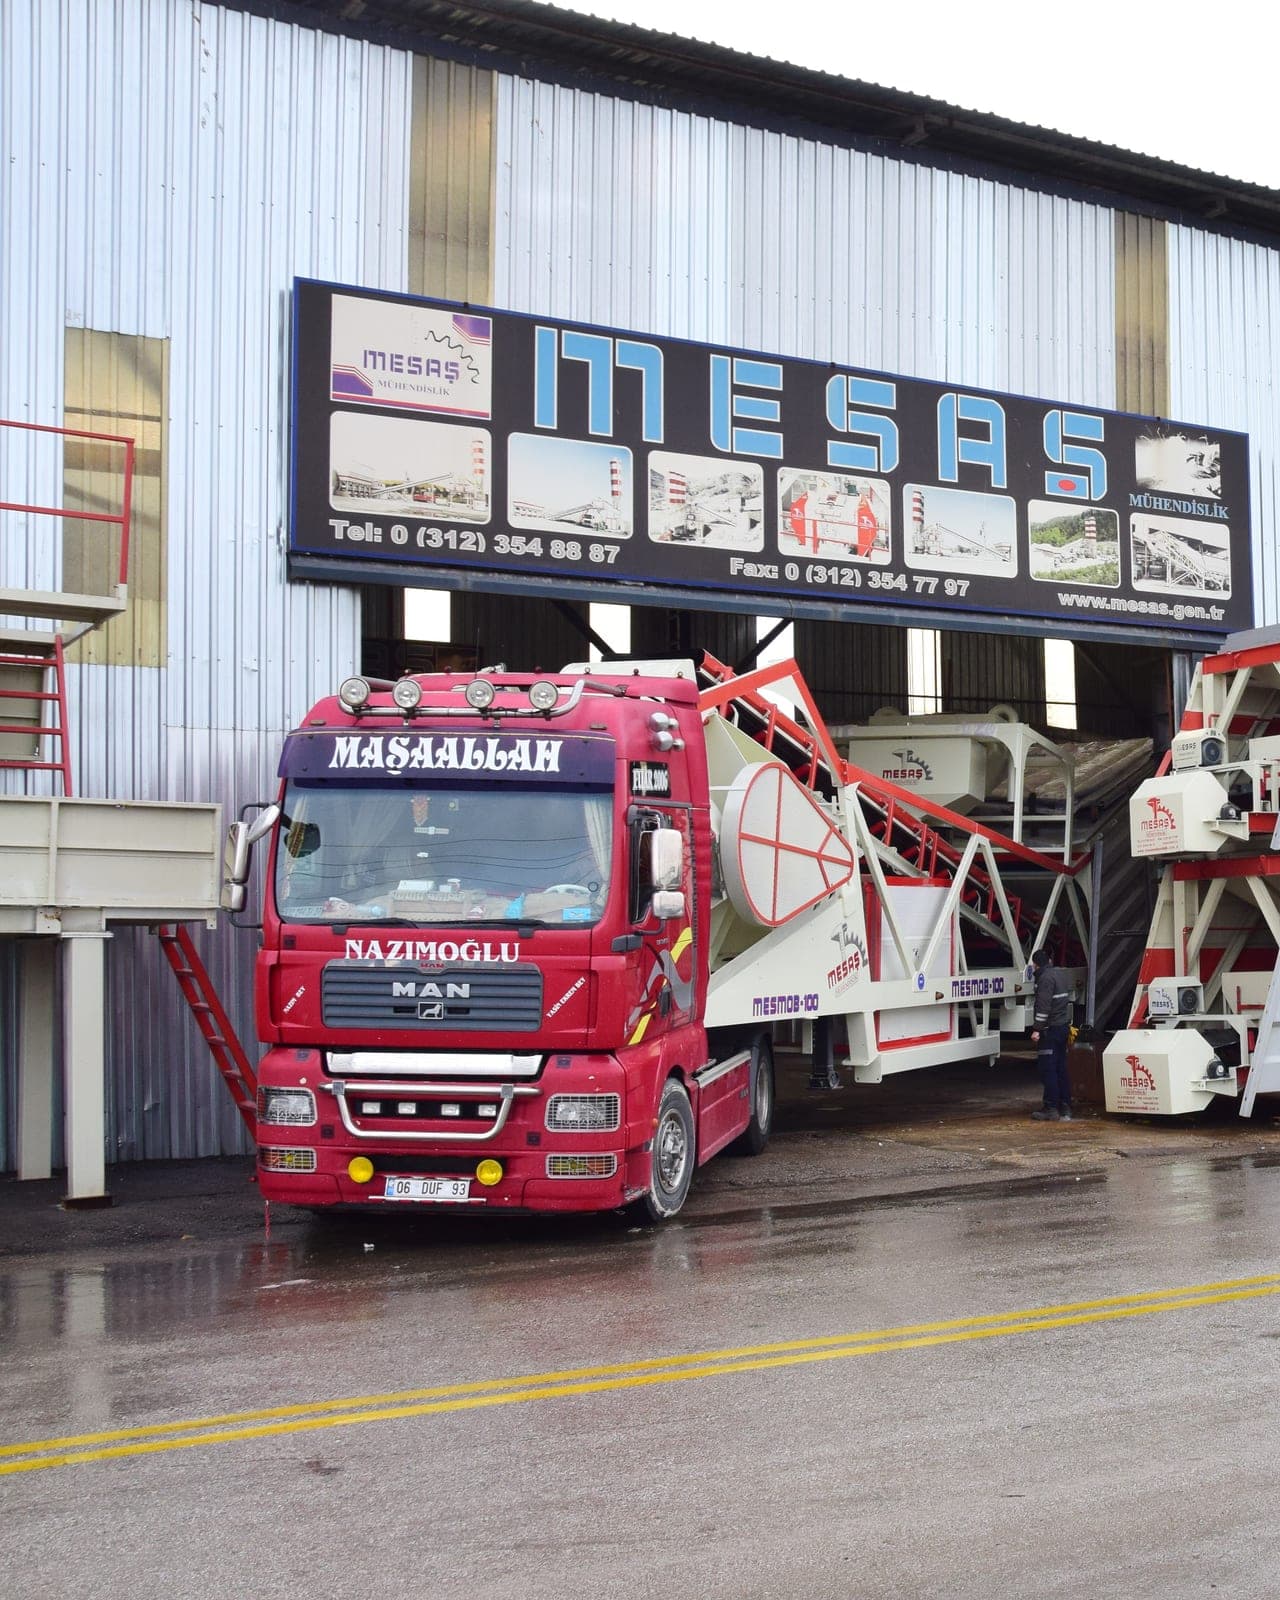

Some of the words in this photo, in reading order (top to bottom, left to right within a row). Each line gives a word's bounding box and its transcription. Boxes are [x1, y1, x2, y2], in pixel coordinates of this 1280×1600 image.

[363, 349, 460, 384] MESAŞ
[377, 379, 451, 397] MÜHENDİSLİK
[1128, 493, 1231, 520] MÜHENDİSLİK
[329, 519, 382, 543] Tel:
[390, 524, 408, 545] 0
[416, 526, 487, 553] (312)
[494, 534, 543, 557] 354
[550, 539, 582, 561] 88
[589, 543, 620, 563] 87
[729, 557, 779, 580] Fax:
[785, 562, 800, 582] 0
[805, 564, 862, 588] (312)
[867, 570, 908, 592] 354
[912, 575, 940, 595] 77
[944, 578, 970, 597] 97
[1057, 592, 1226, 622] www.mesas.gen.tr
[328, 736, 564, 775] MAŞAALLAH
[345, 939, 521, 963] NAZIMOĞLU
[392, 982, 470, 998] MAN
[951, 977, 1005, 997] MESMOB-100
[752, 993, 819, 1016] MESMOB-100
[396, 1181, 411, 1194] 06
[421, 1182, 444, 1195] DUF
[451, 1182, 467, 1196] 93
